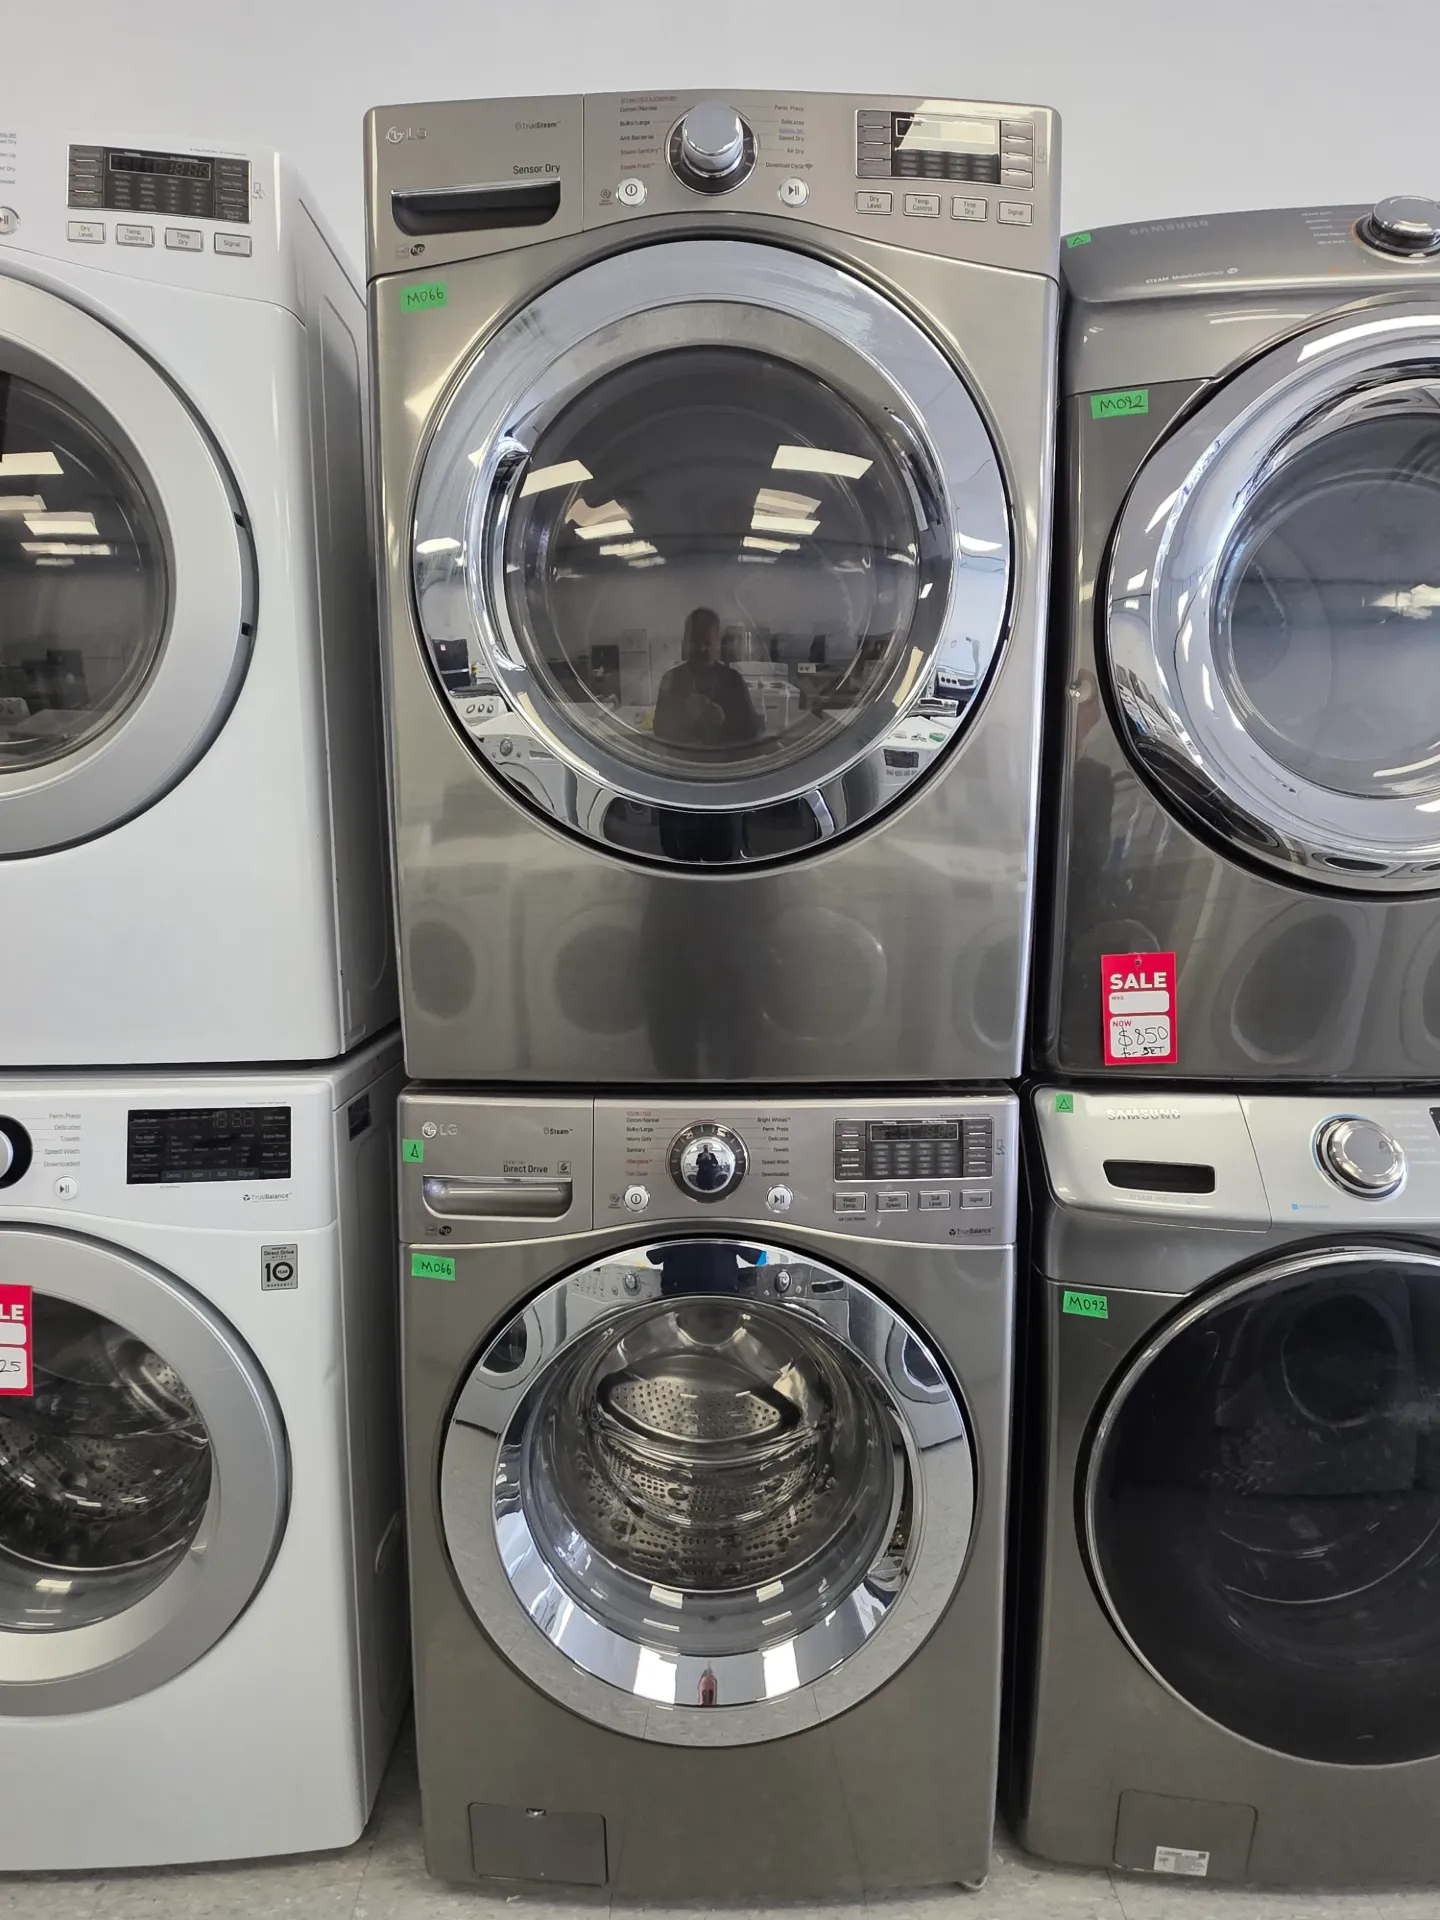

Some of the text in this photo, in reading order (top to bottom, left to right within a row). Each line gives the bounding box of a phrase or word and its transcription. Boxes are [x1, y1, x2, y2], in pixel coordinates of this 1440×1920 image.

[513, 163, 561, 175] Sensor Dry
[80, 225, 90, 233] Dry
[1129, 219, 1209, 236] SAMSUNG
[124, 234, 145, 242] Control
[223, 239, 241, 247] Signal
[1145, 276, 1169, 284] STEAM
[407, 287, 444, 305] M066
[1100, 394, 1145, 413] M092
[1110, 972, 1167, 990] SALE
[1106, 1108, 1181, 1121] SAMSUNG
[503, 1164, 548, 1173] Direct Drive
[265, 1261, 294, 1283] 10
[421, 1261, 453, 1276] M066
[1069, 1296, 1107, 1311] M092
